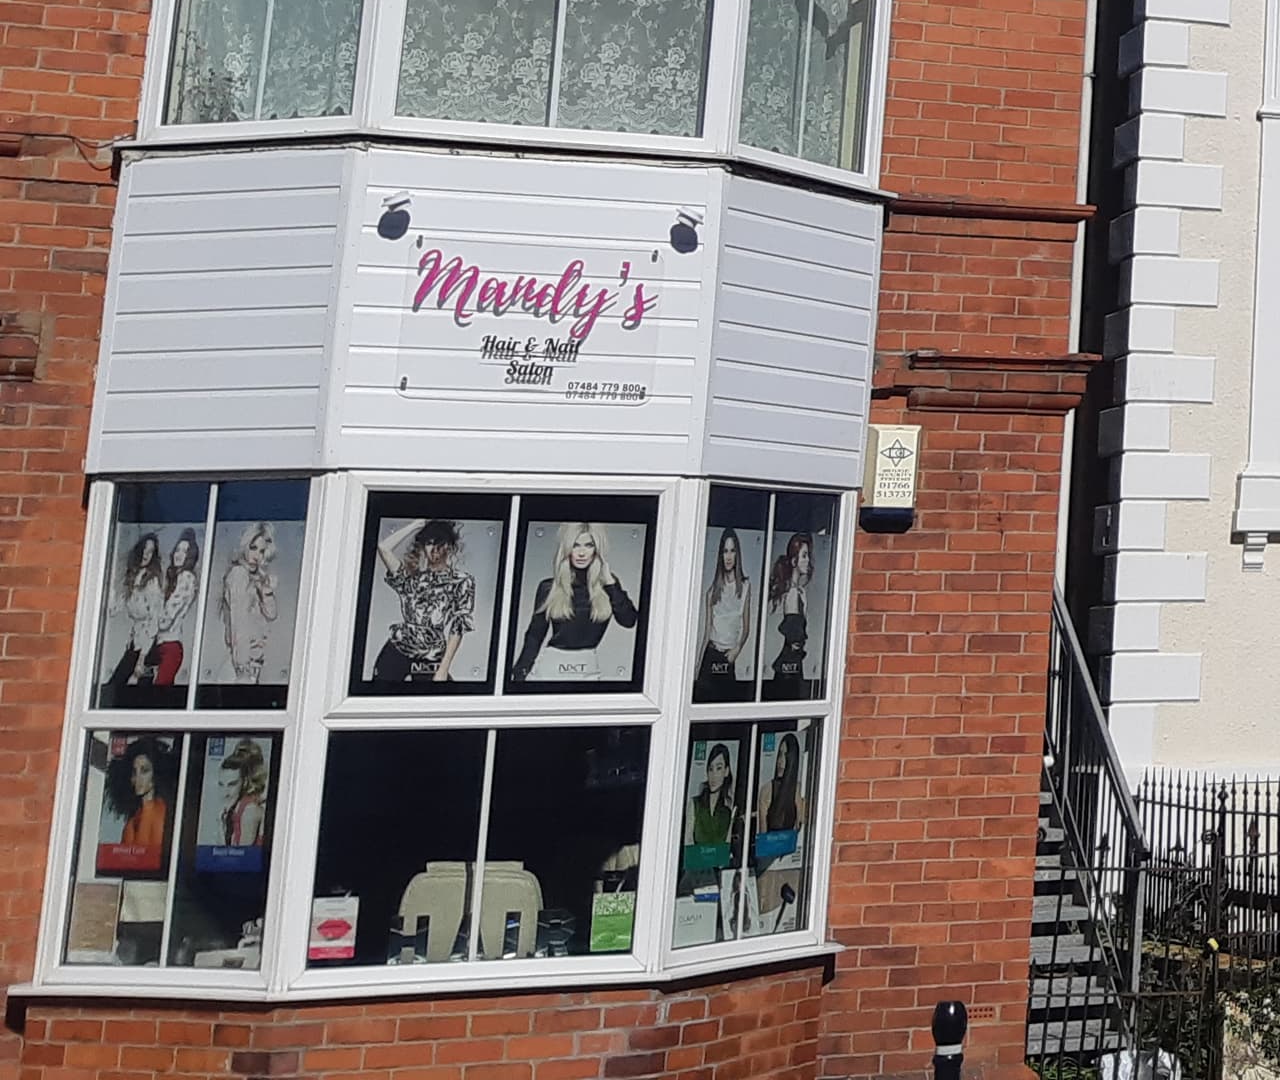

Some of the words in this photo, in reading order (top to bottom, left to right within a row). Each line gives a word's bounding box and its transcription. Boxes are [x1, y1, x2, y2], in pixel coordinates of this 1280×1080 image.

[413, 249, 659, 342] Mandy's
[481, 335, 522, 353] Hair
[524, 336, 540, 353] &
[544, 337, 582, 355] Nail
[505, 359, 553, 377] Salon
[567, 381, 598, 391] 07484
[602, 382, 620, 392] 779
[622, 383, 641, 393] 800
[410, 662, 440, 672] NXT
[558, 663, 588, 672] NXT
